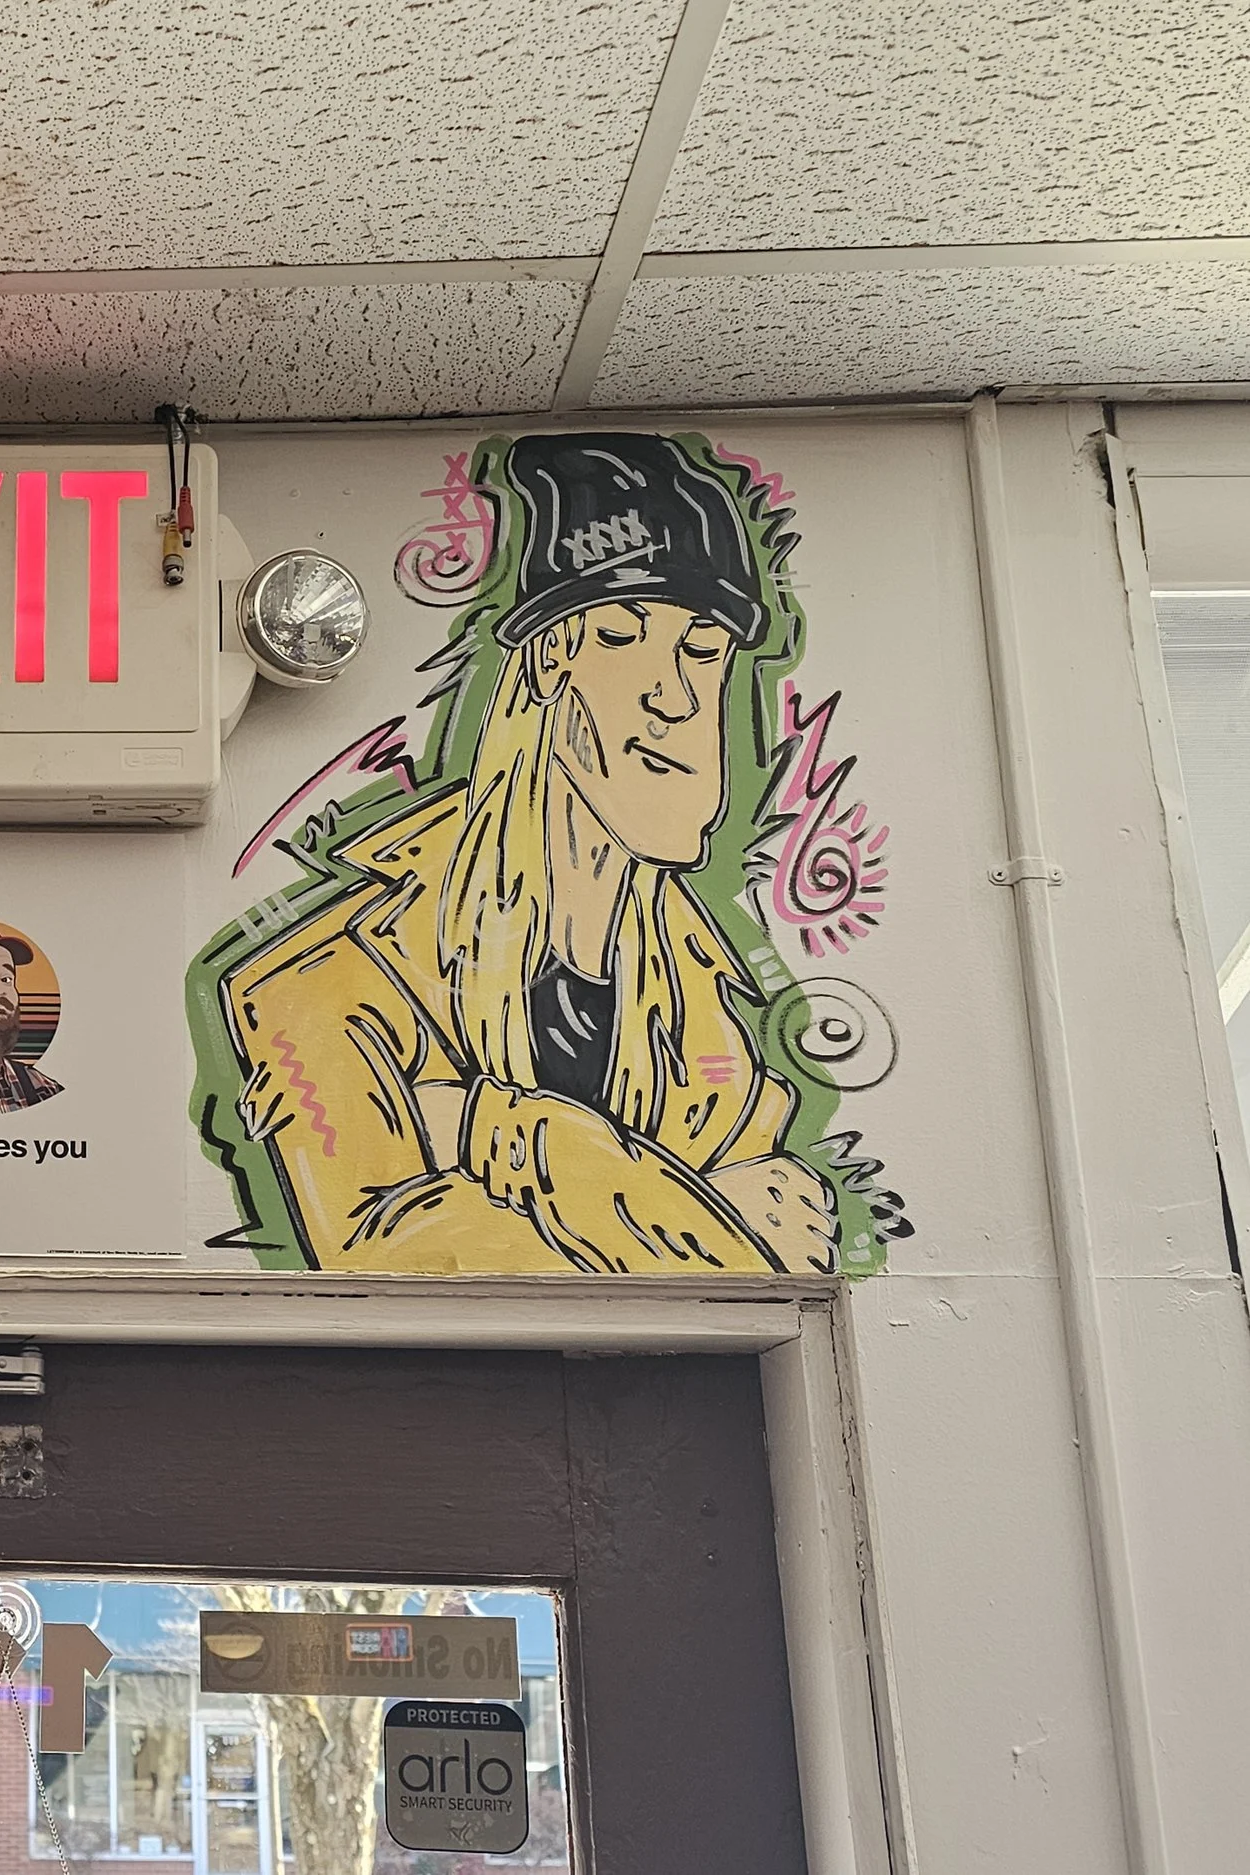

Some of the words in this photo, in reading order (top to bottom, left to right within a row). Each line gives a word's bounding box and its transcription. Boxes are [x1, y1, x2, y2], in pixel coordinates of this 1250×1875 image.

[35, 1139, 88, 1164] you
[406, 1707, 501, 1726] PROTECTED
[397, 1738, 514, 1796] arlo
[399, 1795, 446, 1811] SMART
[448, 1797, 513, 1814] SECURITY
